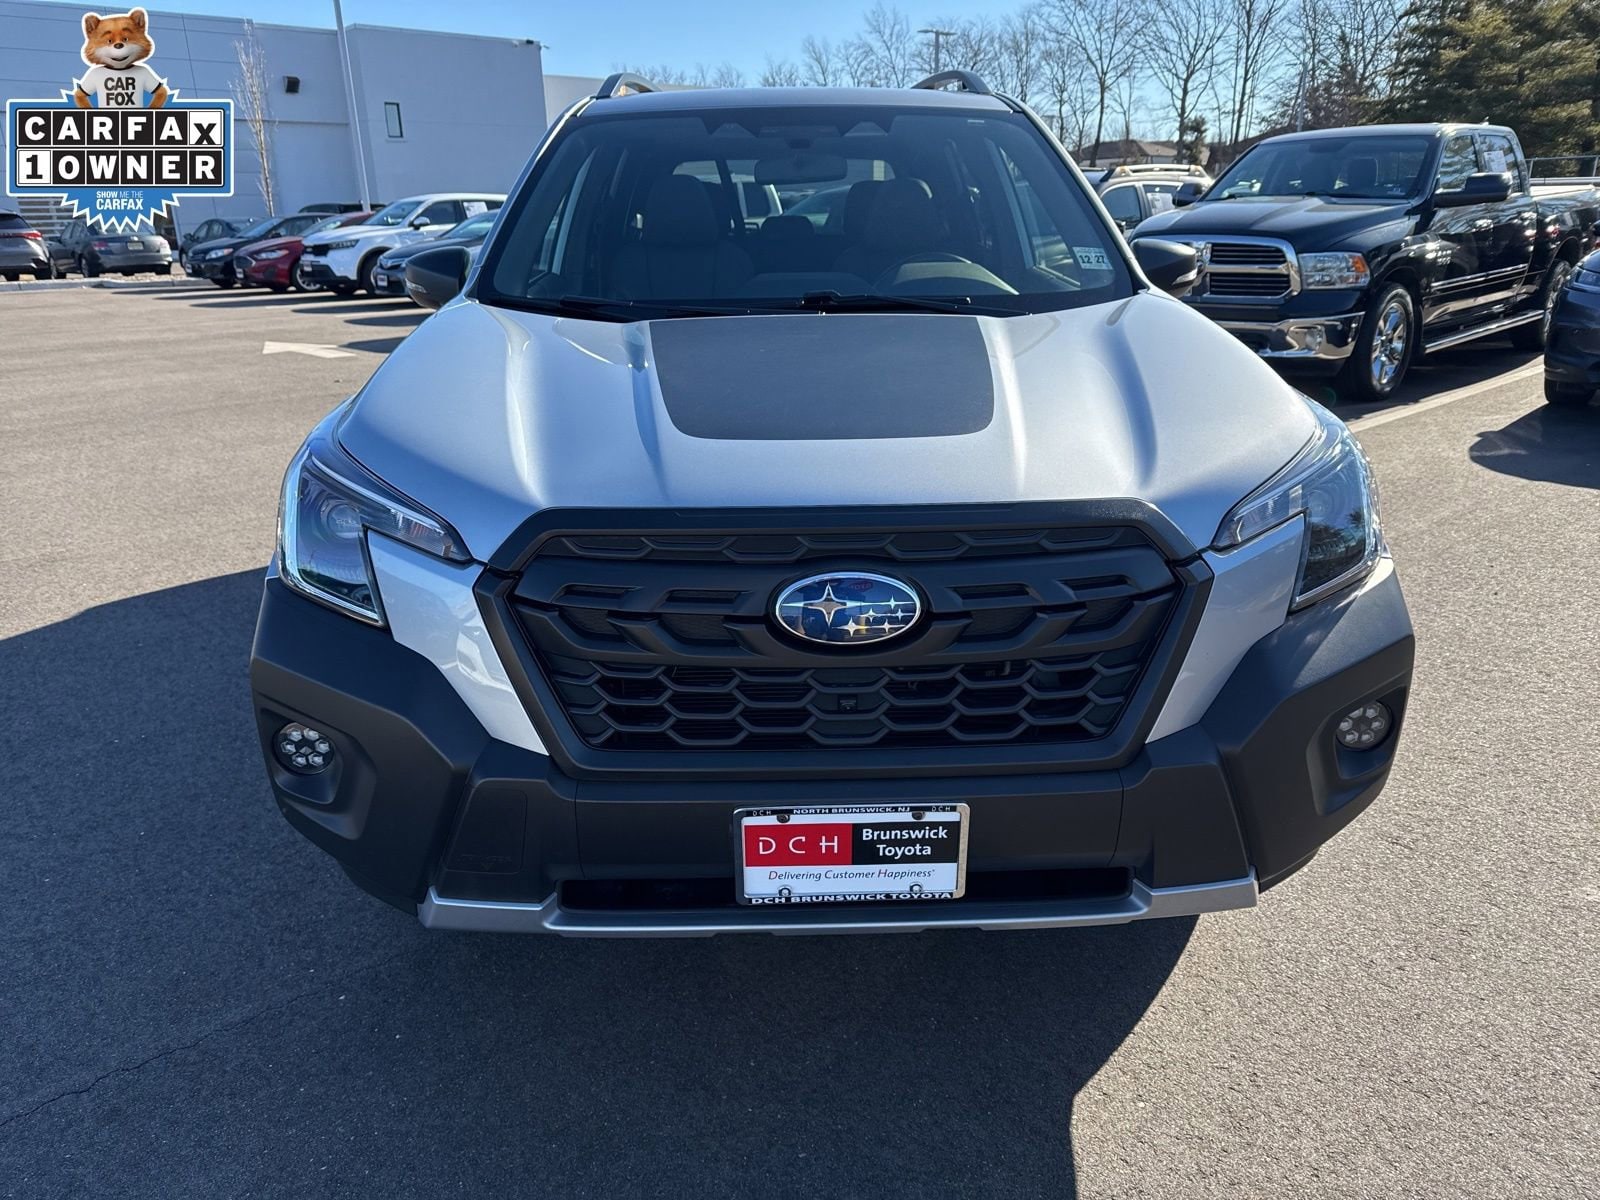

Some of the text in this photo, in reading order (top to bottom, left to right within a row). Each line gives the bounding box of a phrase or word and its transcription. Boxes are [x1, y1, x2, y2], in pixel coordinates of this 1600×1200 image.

[1079, 254, 1093, 264] 12
[862, 826, 948, 841] Brunswick
[876, 844, 932, 860] Toyota
[768, 870, 822, 882] Delivering
[824, 869, 876, 879] Customer
[751, 892, 952, 905] DCH BRUNSWICK TOYOTA
